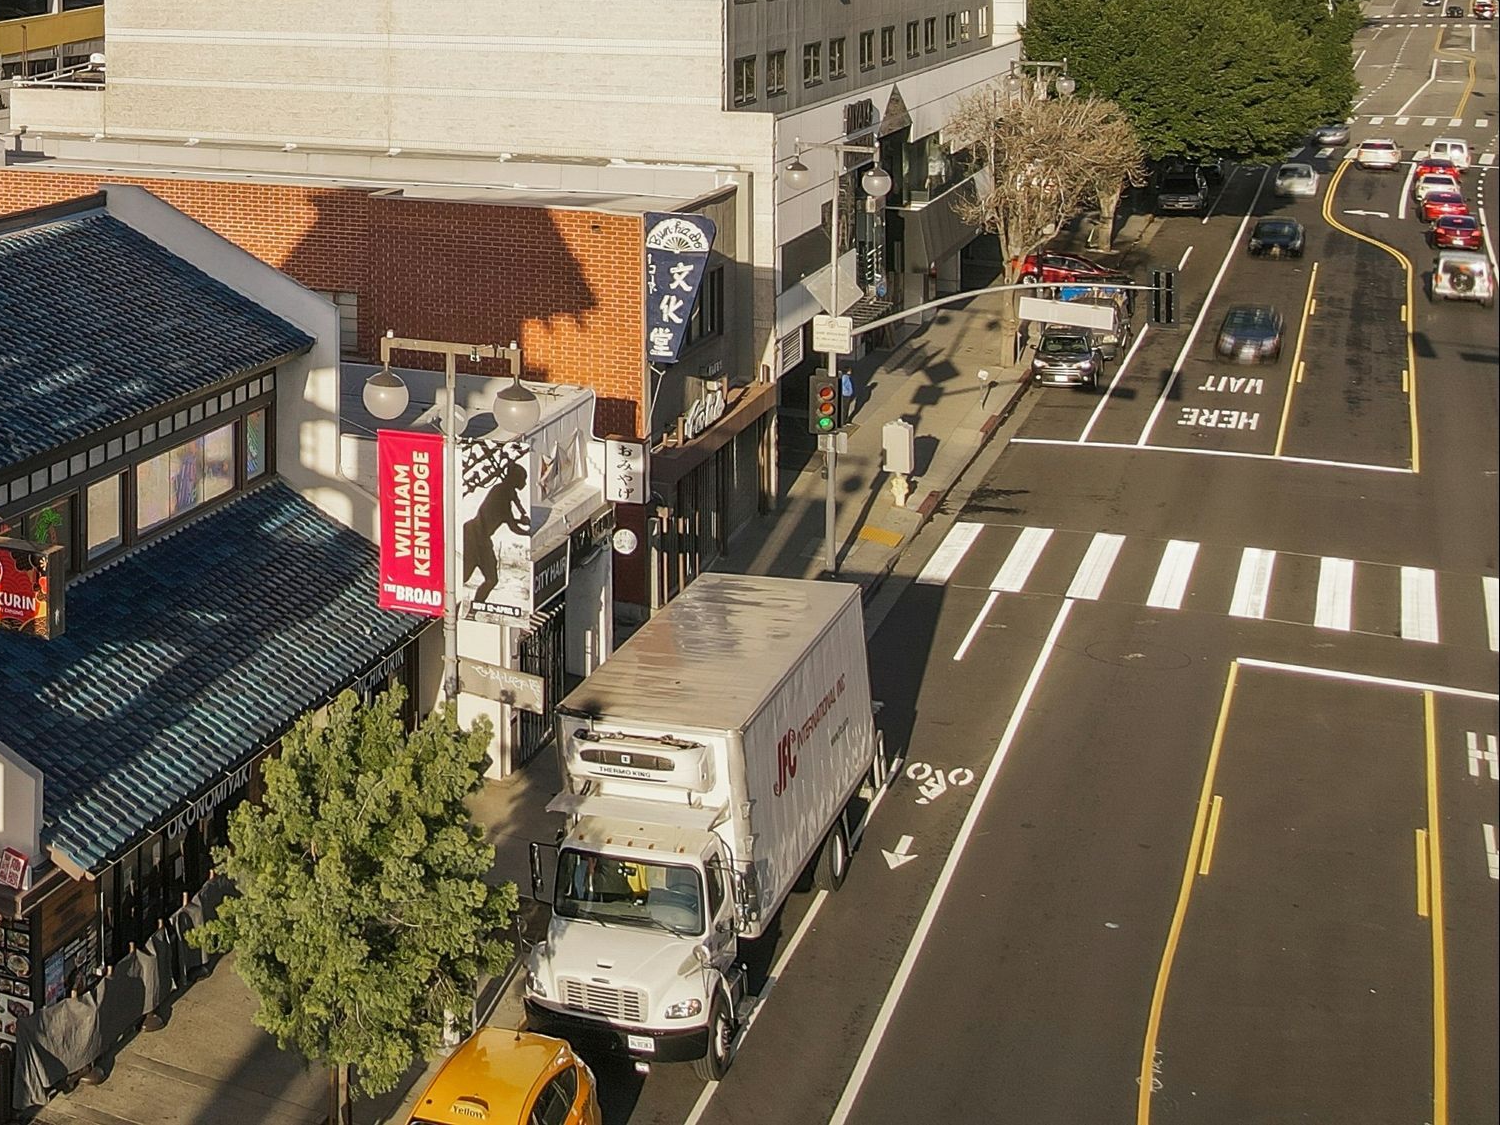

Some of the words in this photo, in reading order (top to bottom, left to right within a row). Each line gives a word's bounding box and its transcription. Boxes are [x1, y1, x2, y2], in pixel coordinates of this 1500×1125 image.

[649, 261, 695, 358] 文化堂
[1198, 375, 1264, 395] WAIT
[1177, 407, 1260, 430] HERE
[616, 444, 635, 501] おみやげ
[393, 464, 412, 558] WILLIAM
[412, 451, 431, 577] KENTRIDGE
[383, 582, 396, 593] THE
[396, 586, 442, 607] BROAD
[534, 567, 550, 594] CITY
[550, 557, 566, 582] HAIR
[599, 766, 632, 776] THERMO
[632, 770, 651, 778] KING
[773, 727, 796, 797] JFC
[167, 762, 253, 840] OKONOMIYAKI
[453, 1105, 484, 1118] Yellow
